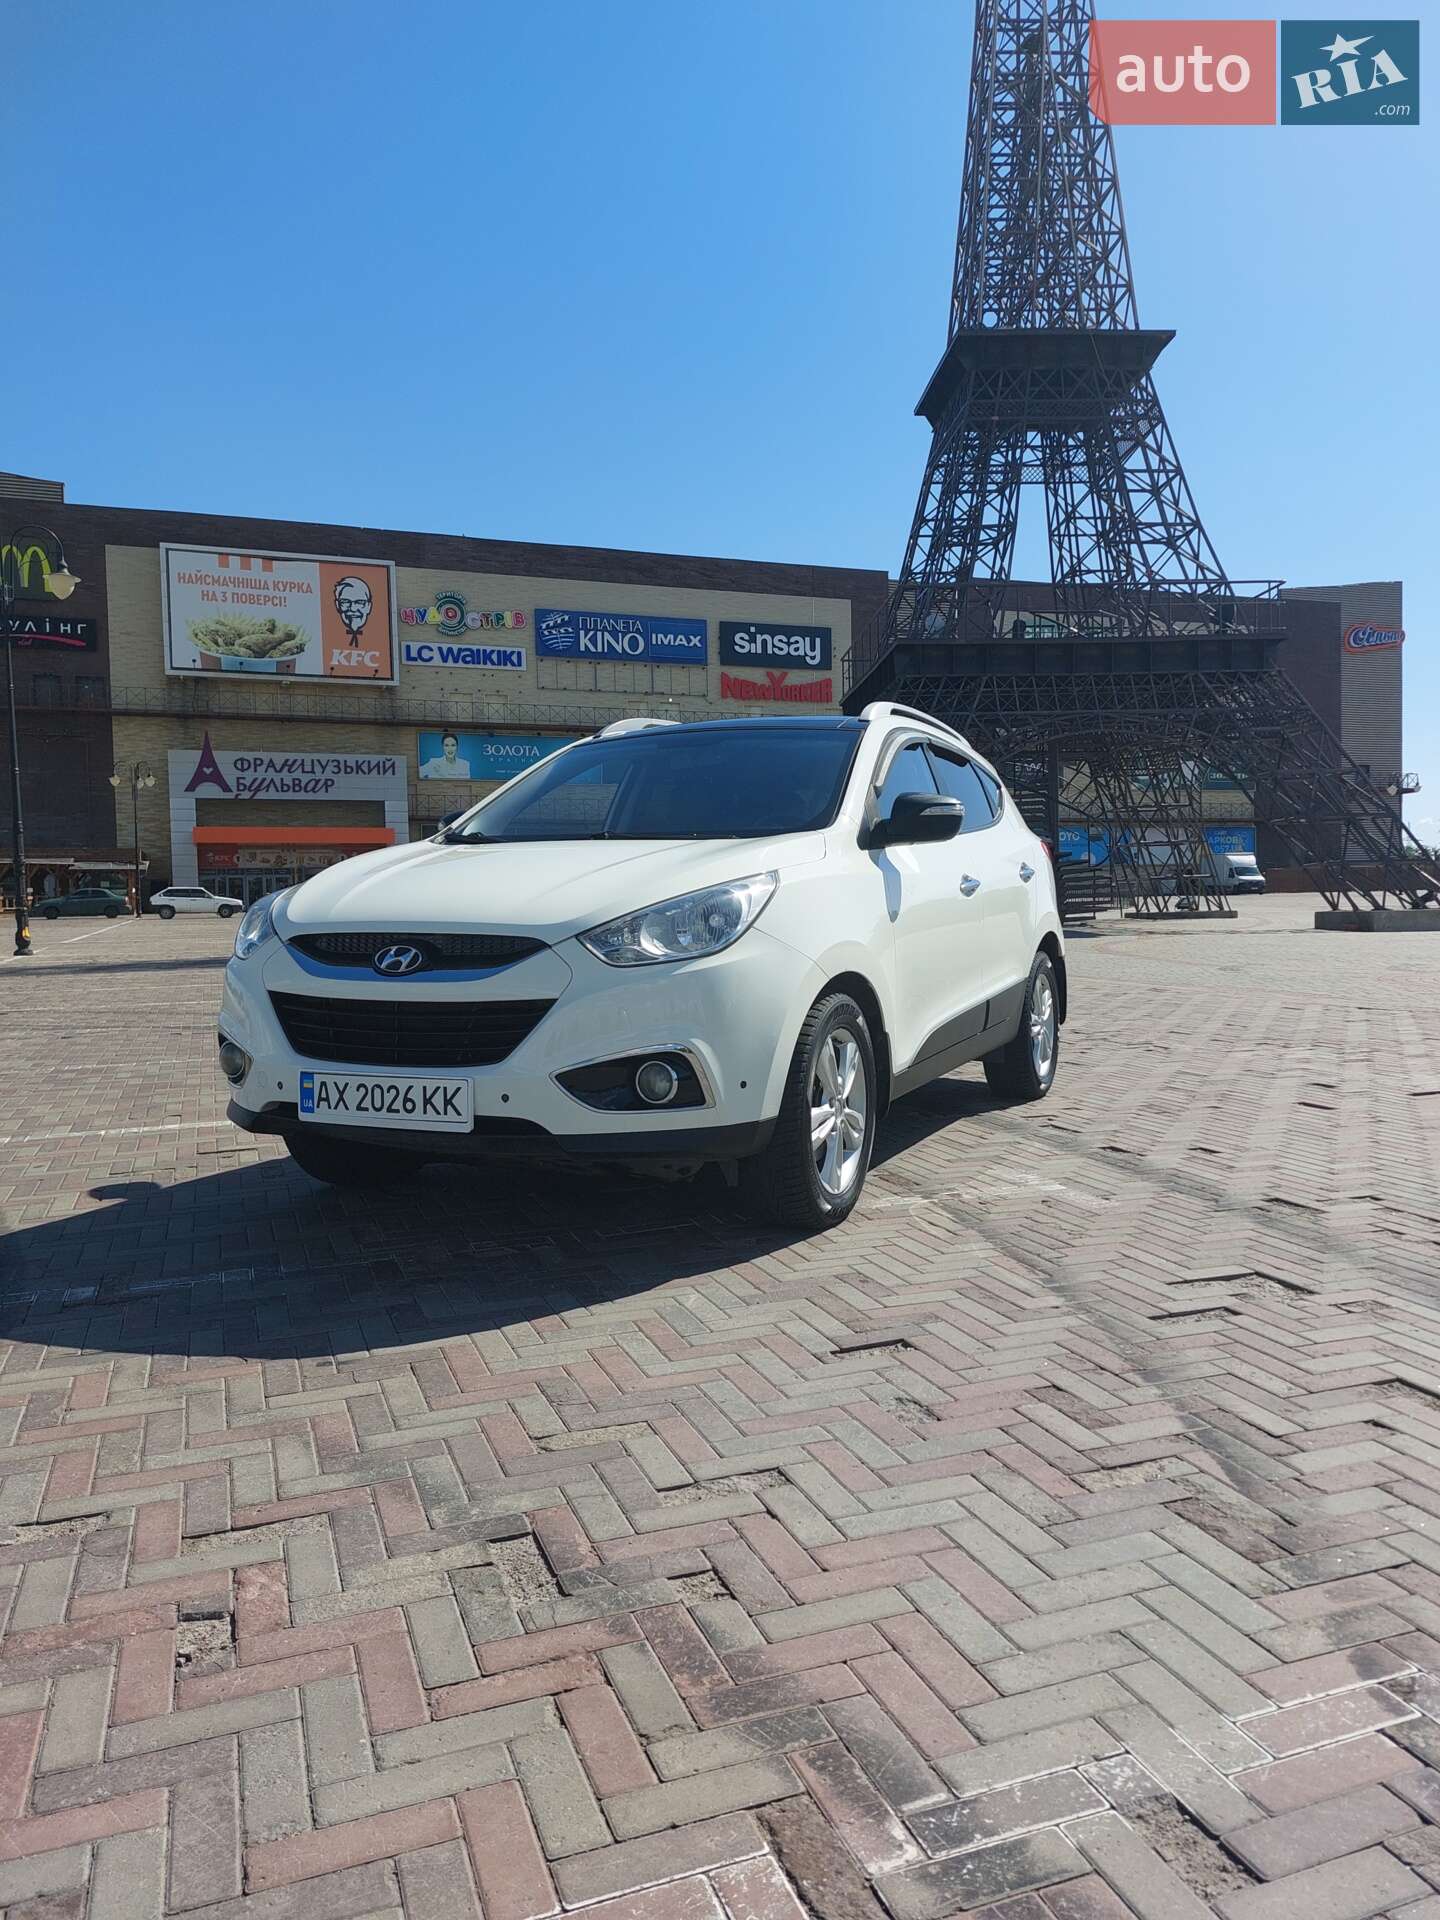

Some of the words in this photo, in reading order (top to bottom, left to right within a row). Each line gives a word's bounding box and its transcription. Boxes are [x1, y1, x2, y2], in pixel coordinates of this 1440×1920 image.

[177, 570, 270, 591] НАЙСМАЧНІША
[272, 580, 313, 594] КУРКА
[201, 590, 219, 603] НА
[220, 591, 228, 603] 3
[231, 593, 288, 608] ПОВЕРСІ!
[579, 617, 644, 633] ПЛАНЕТА
[579, 630, 645, 655] KINO
[652, 633, 703, 647] IMAX
[734, 626, 821, 665] sinsay
[330, 649, 381, 667] KFC
[405, 644, 435, 663] LC
[483, 744, 541, 757] ЗОЛОТА
[233, 757, 396, 776] ФРАНЦУЗЬКИЙ
[235, 776, 335, 799] БУЛЬВАР
[303, 1099, 314, 1108] UA
[316, 1081, 350, 1111] AX
[355, 1083, 417, 1115] 2026
[422, 1085, 463, 1117] KK
